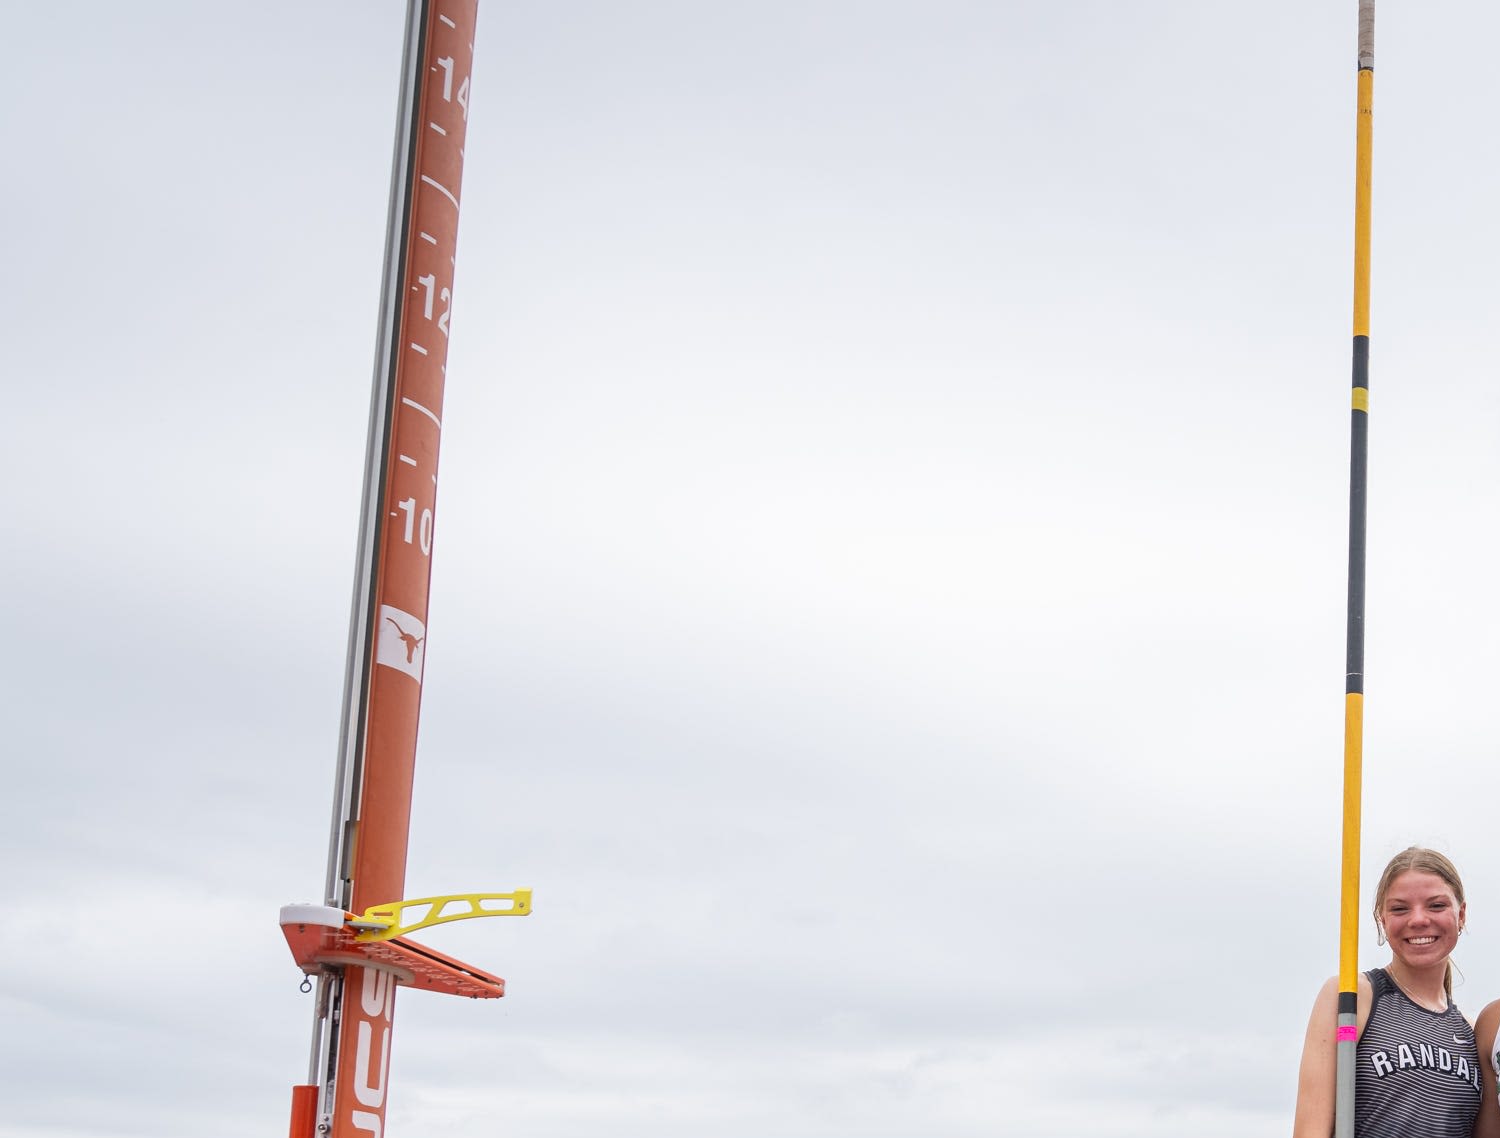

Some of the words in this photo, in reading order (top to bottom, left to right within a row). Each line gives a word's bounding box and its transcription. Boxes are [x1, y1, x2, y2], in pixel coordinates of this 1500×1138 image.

[437, 56, 471, 122] 14
[419, 273, 452, 337] 12
[397, 497, 433, 557] 10
